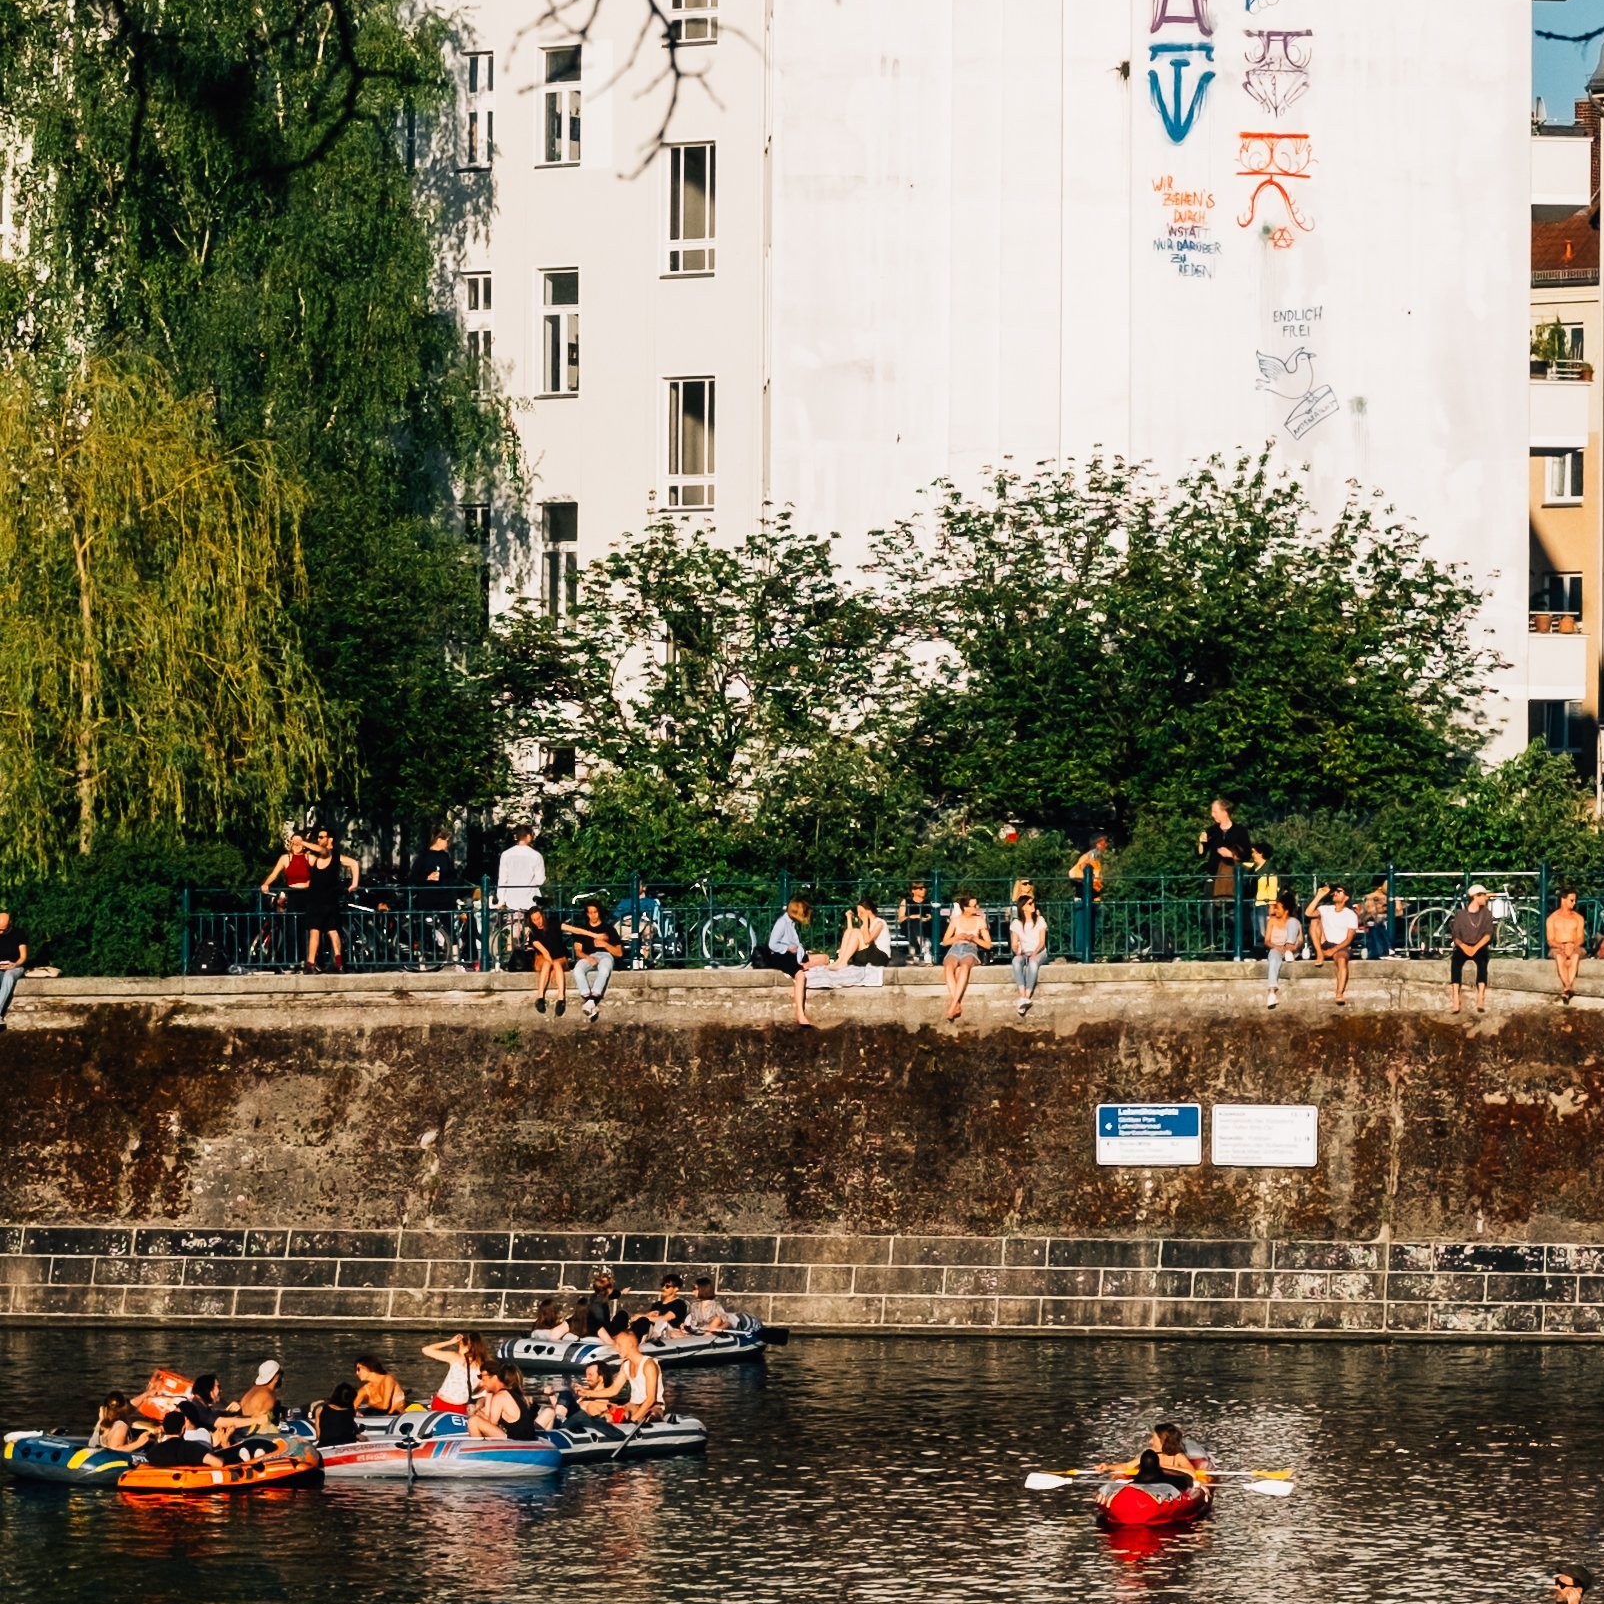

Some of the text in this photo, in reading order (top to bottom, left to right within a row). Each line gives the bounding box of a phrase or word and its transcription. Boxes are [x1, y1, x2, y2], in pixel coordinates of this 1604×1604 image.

[1152, 174, 1174, 192] WIR
[1173, 209, 1206, 225] DURCH
[1153, 238, 1174, 251] NUR
[1170, 254, 1187, 263] ZU
[1273, 304, 1323, 323] ENDLICH
[1282, 324, 1310, 338] FREI
